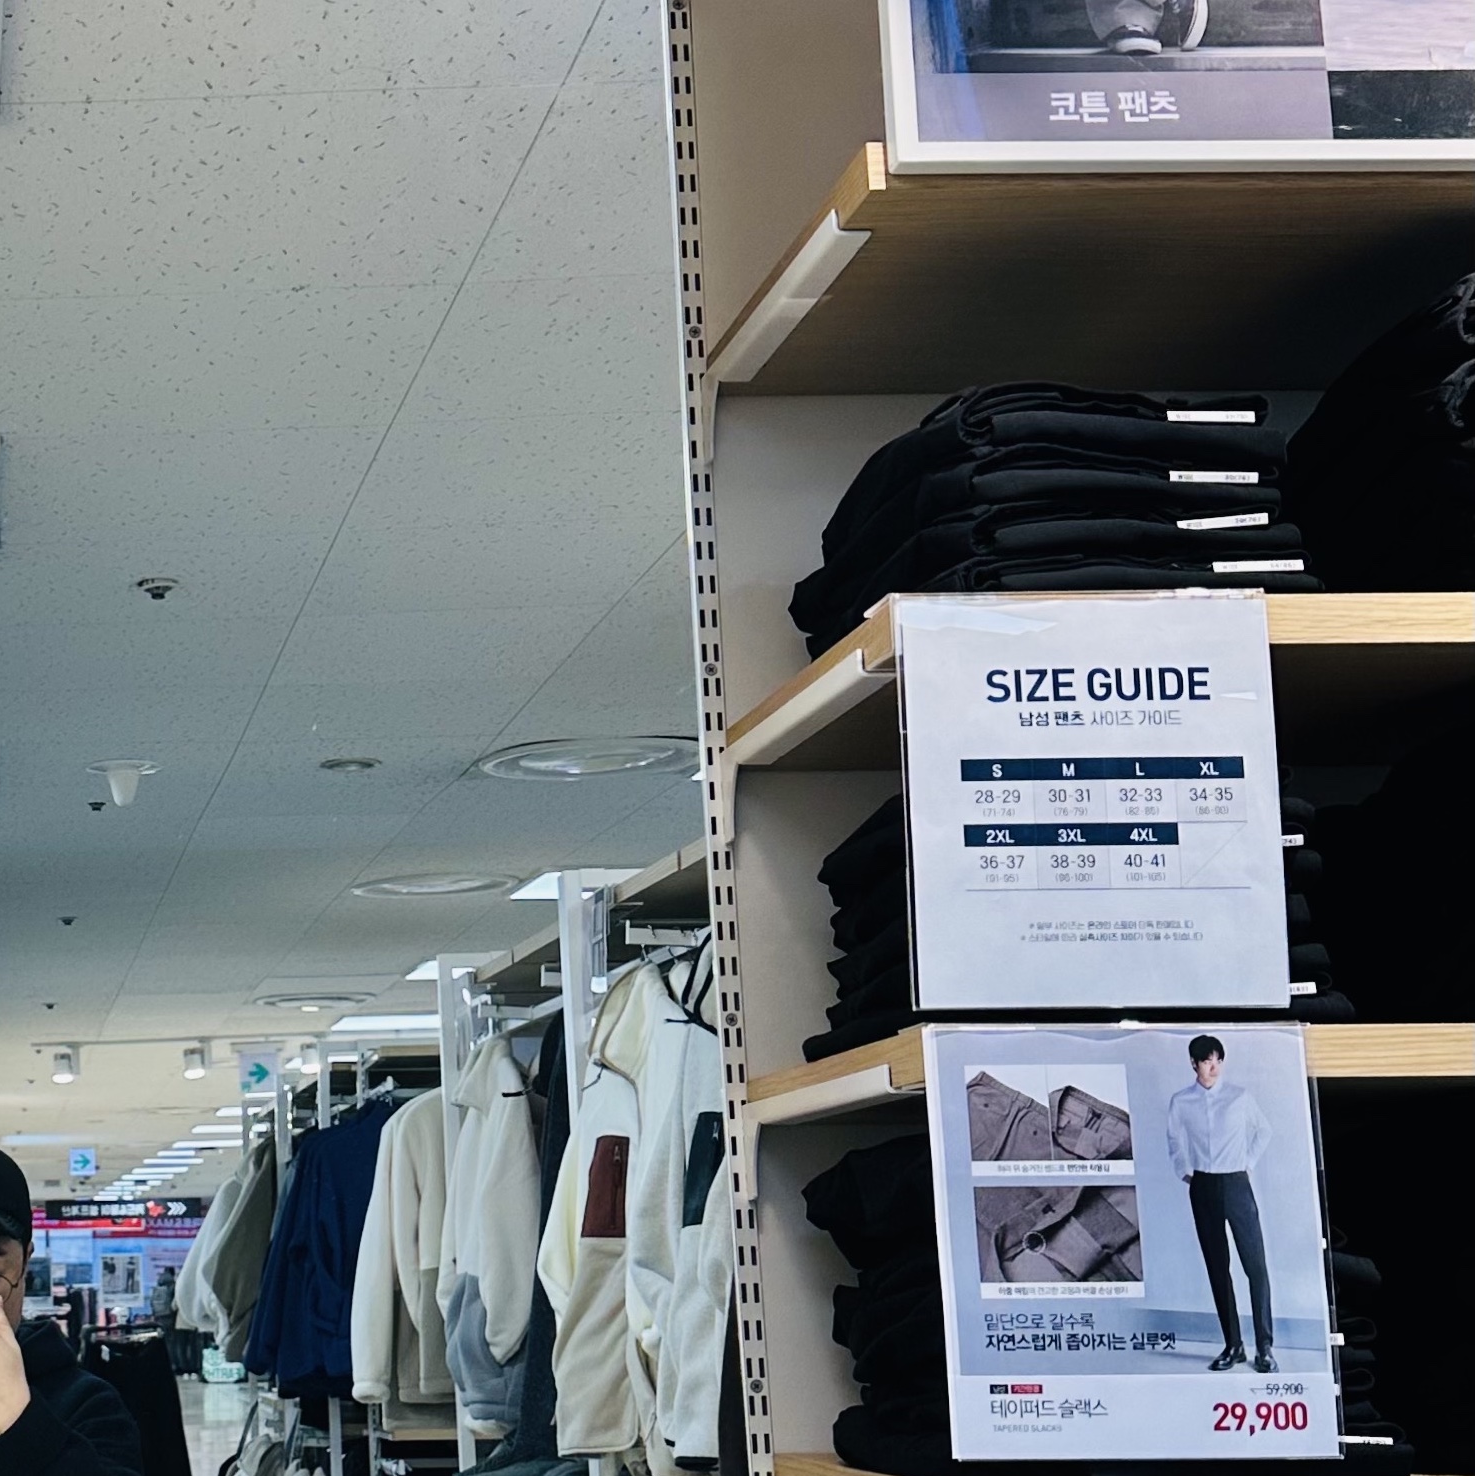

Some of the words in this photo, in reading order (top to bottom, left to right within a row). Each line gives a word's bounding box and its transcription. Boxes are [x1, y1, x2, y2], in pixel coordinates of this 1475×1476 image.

[1049, 91, 1109, 123] 코튼
[1118, 89, 1180, 123] 팬츠
[986, 669, 1077, 703] SIZE
[1087, 667, 1211, 701] GUIDE
[1019, 712, 1050, 727] 남성
[1055, 712, 1085, 726] 팬츠
[1090, 711, 1134, 726] 사이즈
[1138, 710, 1183, 726] 가이드
[992, 764, 1002, 778] S
[1062, 763, 1075, 777] M
[1136, 763, 1145, 776] L
[1199, 762, 1219, 775] XL
[975, 790, 1021, 803] 28-29
[1048, 789, 1091, 802] 30-31
[1119, 788, 1162, 802] 32-33
[1189, 788, 1233, 801] 34-35
[982, 807, 1015, 817] (71-74)
[1054, 807, 1088, 817] (76-79)
[986, 830, 1014, 843] 2XL
[1058, 829, 1086, 843] 3XL
[1130, 828, 1157, 842] 4XL
[980, 855, 1024, 869] 36-37
[1051, 855, 1096, 868] 38-39
[1124, 854, 1166, 868] 40-41
[984, 1313, 1046, 1330] 밑단으로
[1049, 1313, 1094, 1330] 갈수록
[985, 1333, 1062, 1352] 자연스럽게
[1066, 1332, 1126, 1351] 좁아지는
[1265, 1383, 1304, 1397] 59,900
[991, 1399, 1057, 1418] 테이퍼드
[1058, 1398, 1109, 1418] 슬랙스
[1213, 1402, 1308, 1437] 29,900
